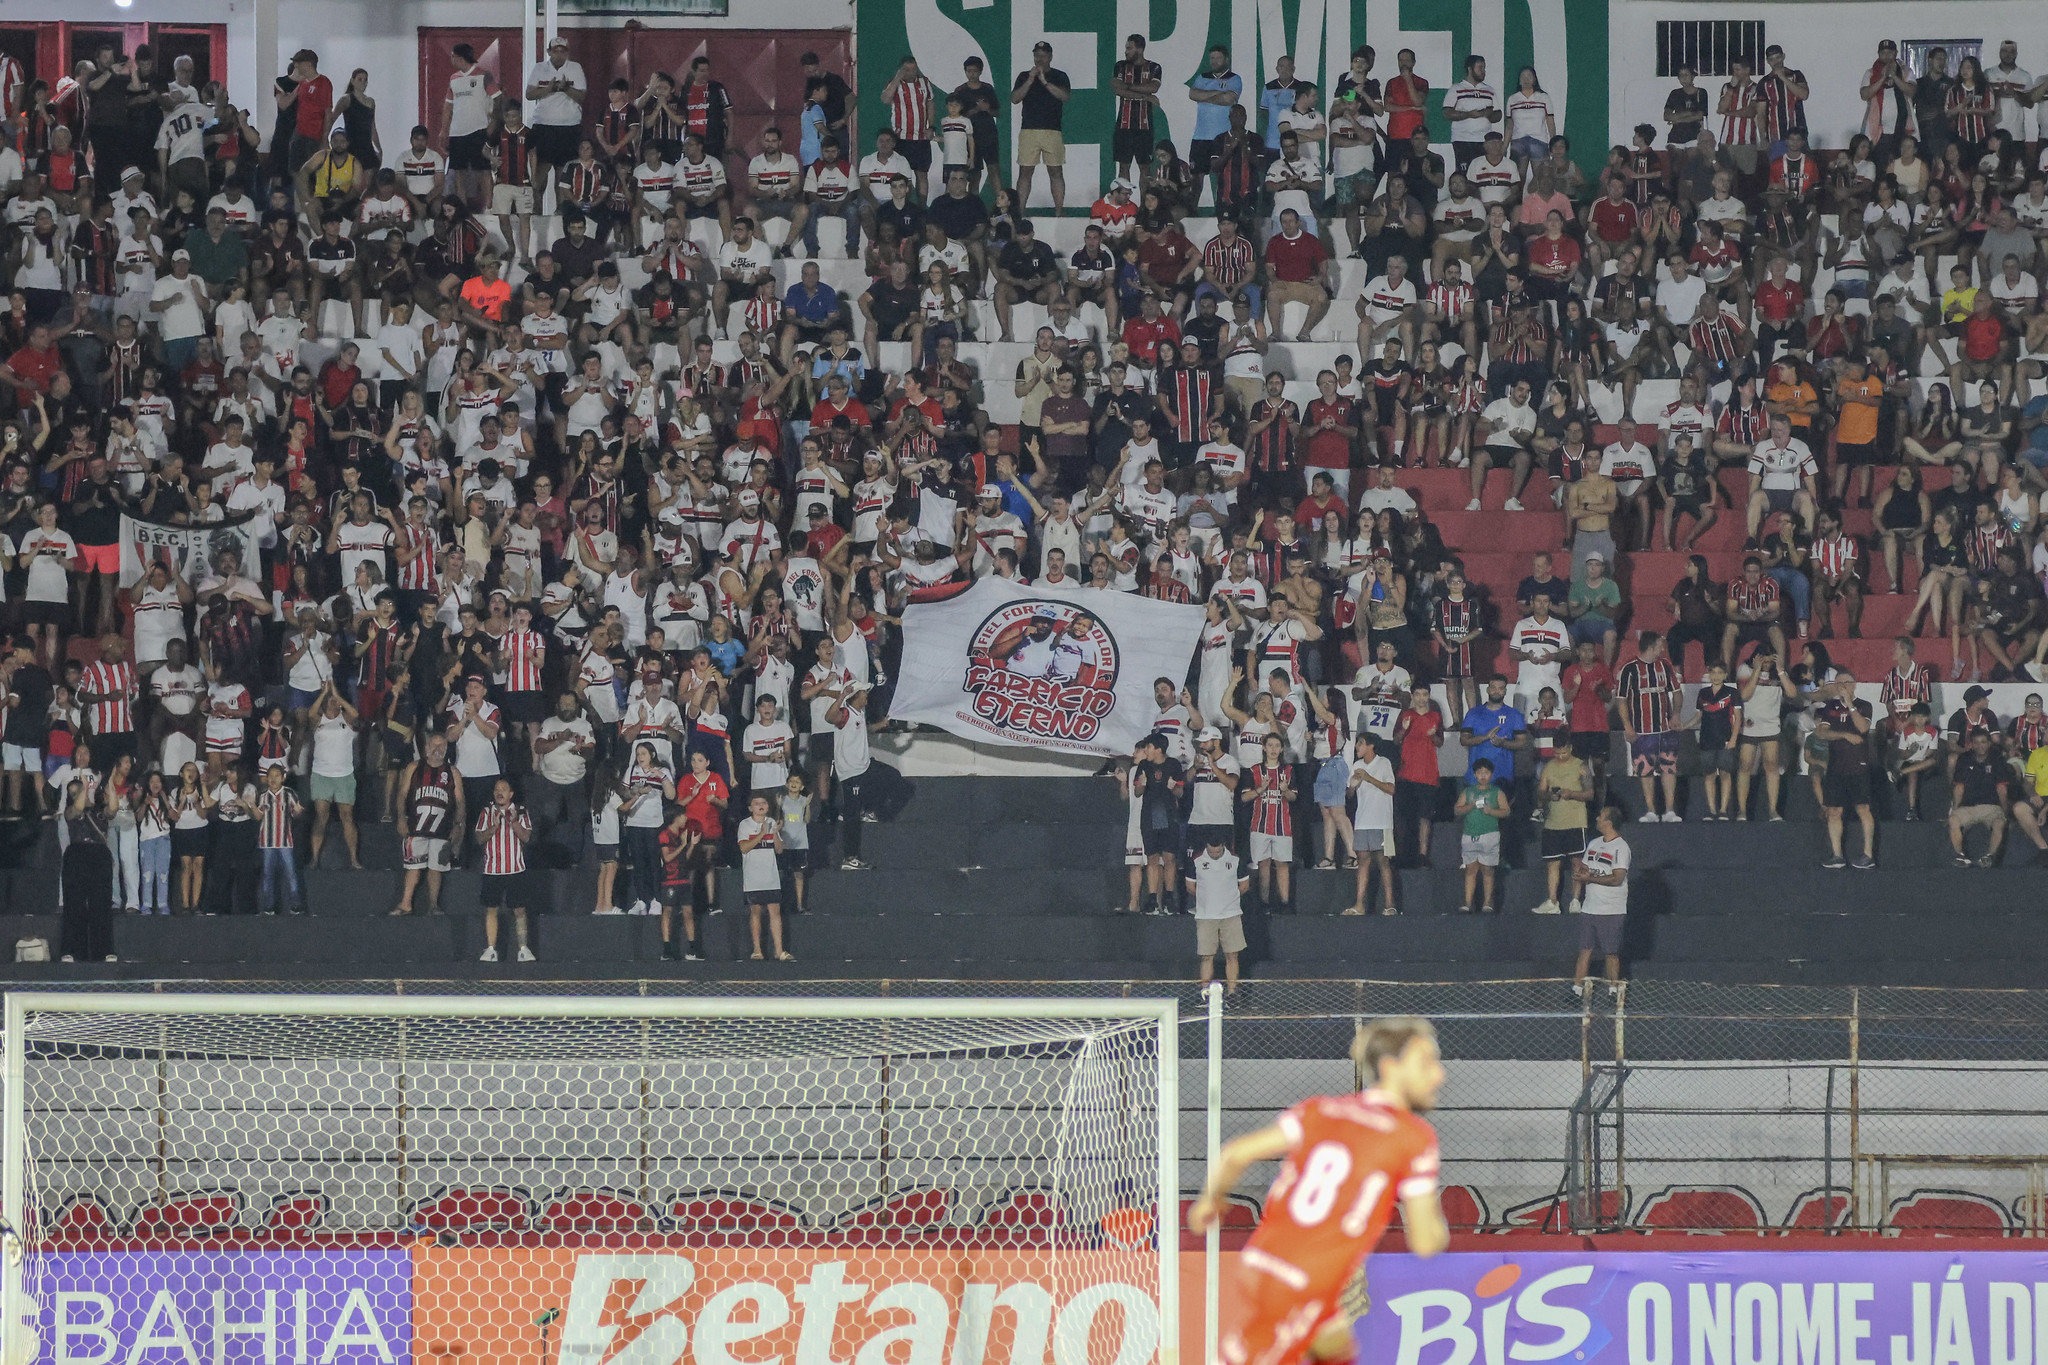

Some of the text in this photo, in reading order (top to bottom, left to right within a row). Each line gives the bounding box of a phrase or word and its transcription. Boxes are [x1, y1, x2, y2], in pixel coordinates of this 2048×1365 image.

[169, 113, 192, 138] 10
[138, 528, 186, 547] B.F.C.
[977, 621, 1003, 646] FIEL
[965, 665, 1114, 718] FABRÍCIO
[956, 711, 1000, 736] GUERREIRO
[975, 690, 1099, 741] ETERNO
[1370, 711, 1389, 728] 21
[416, 805, 446, 833] 77
[557, 1254, 1160, 1365] Betano
[1628, 1281, 1673, 1365] O
[1688, 1281, 1877, 1365] NOME
[1890, 1264, 1977, 1365] JÁ
[55, 1288, 396, 1365] BAHIA
